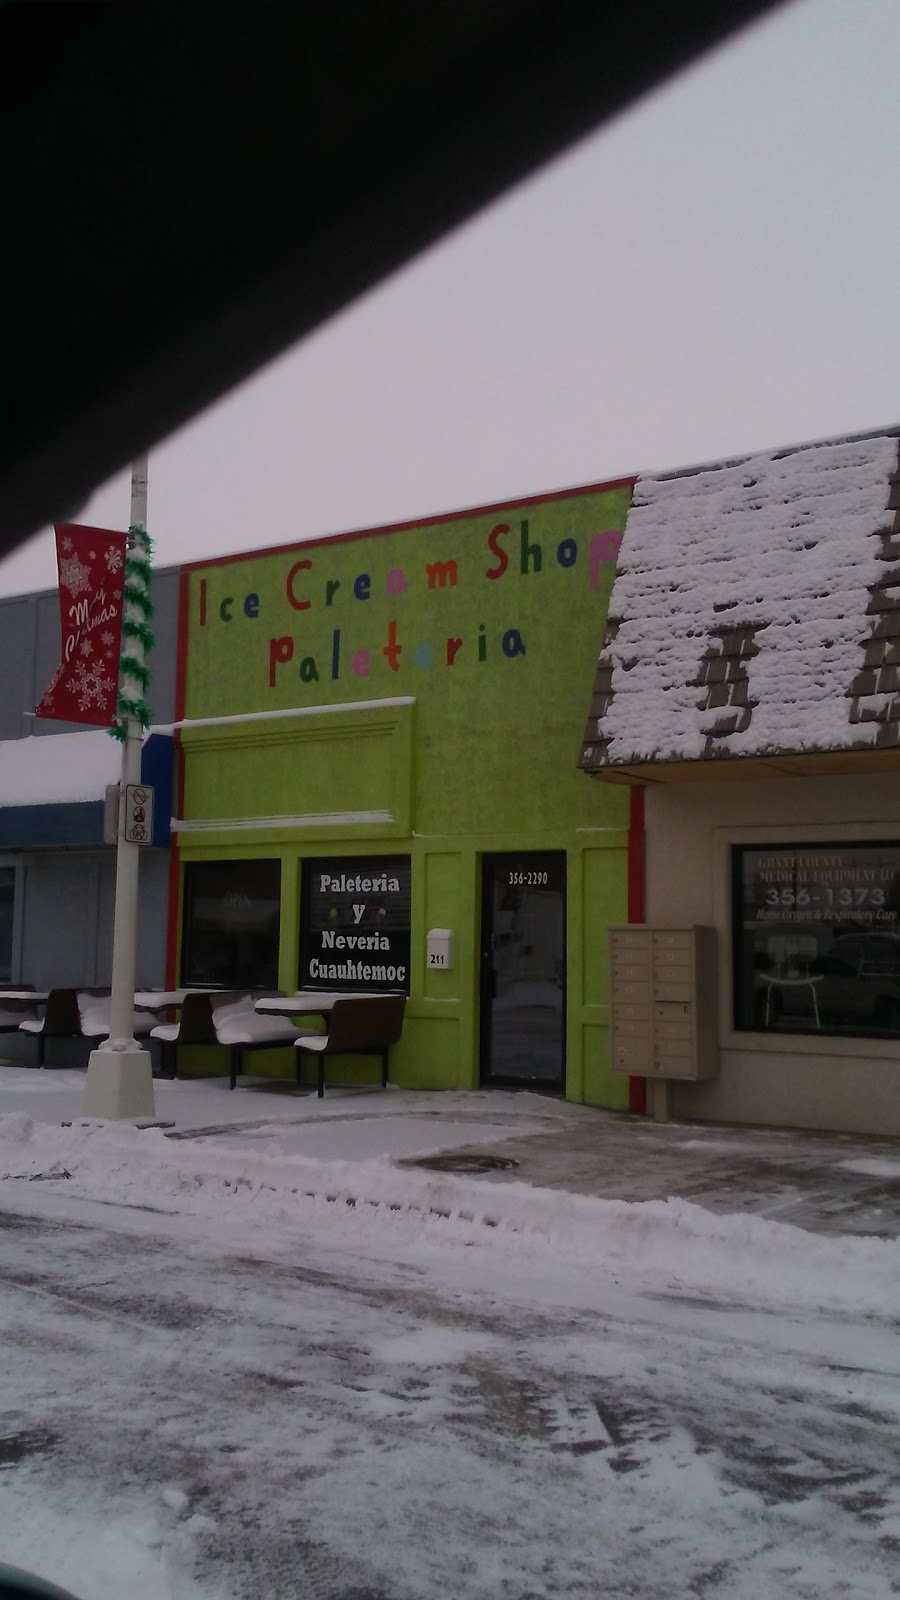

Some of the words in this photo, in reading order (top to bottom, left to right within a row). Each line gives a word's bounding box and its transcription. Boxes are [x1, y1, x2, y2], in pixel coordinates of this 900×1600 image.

[199, 579, 260, 626] Ice
[286, 559, 458, 611] Cream
[485, 519, 623, 591] Shop
[320, 873, 400, 893] Paleteria
[509, 871, 548, 885] 356-2290
[766, 888, 886, 906] 356-1373
[352, 904, 366, 924] y
[321, 930, 390, 951] Neveria
[430, 954, 445, 964] 211
[309, 958, 406, 982] Cuauhtemoc
